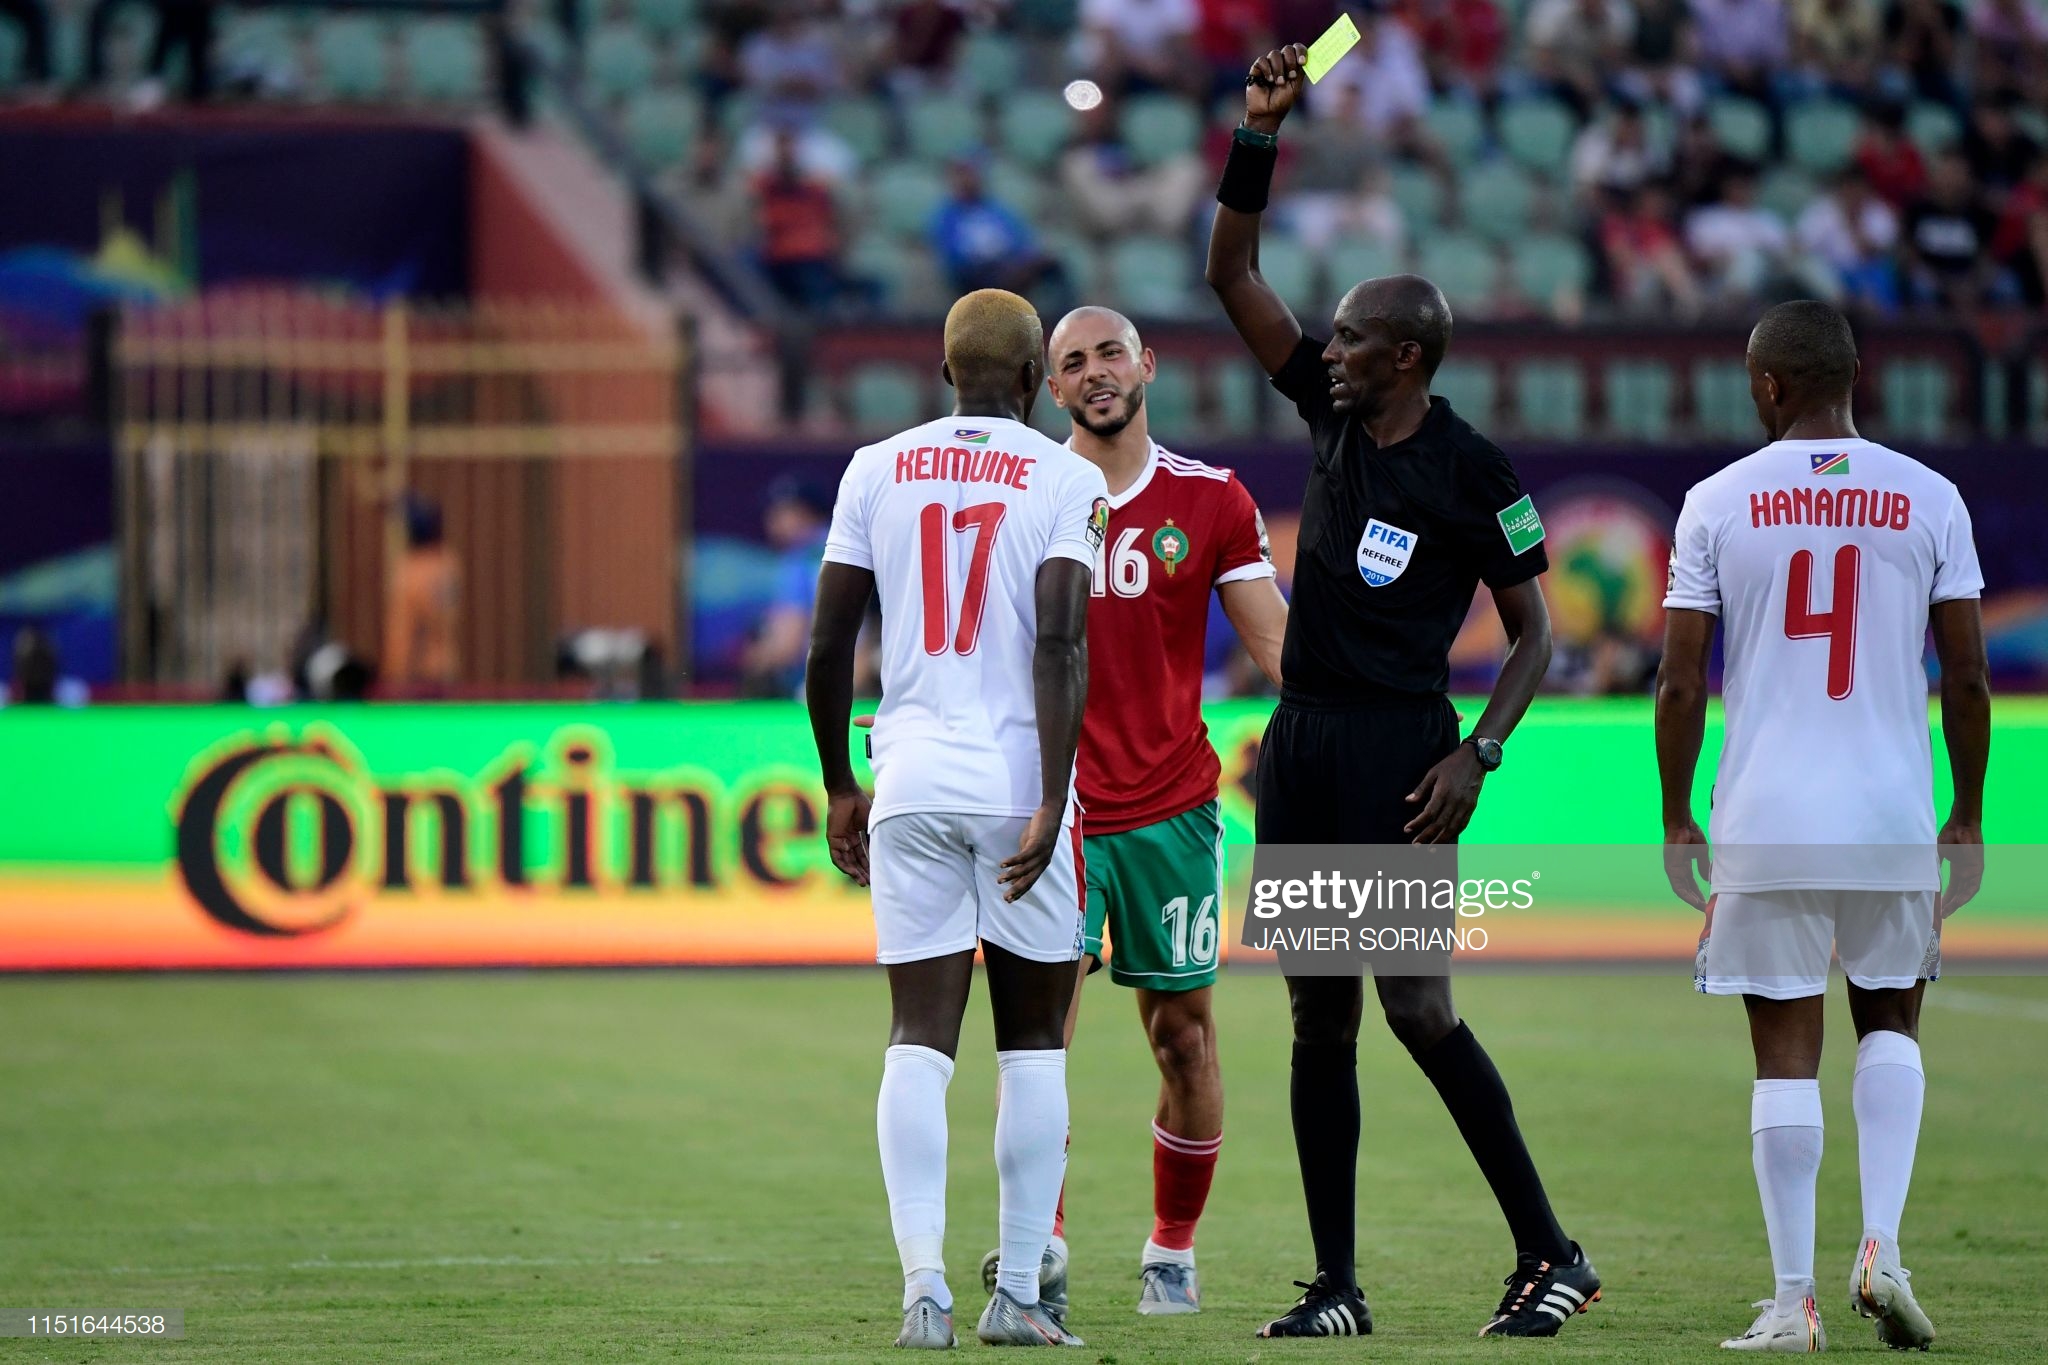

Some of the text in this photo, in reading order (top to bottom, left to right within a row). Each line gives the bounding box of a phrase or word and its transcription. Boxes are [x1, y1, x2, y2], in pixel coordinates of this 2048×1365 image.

[895, 446, 1036, 491] KEIMUINE
[1368, 524, 1408, 551] FIFA
[1750, 487, 1910, 531] HANAMUB
[919, 501, 1007, 657] 17
[1090, 527, 1149, 599] 16
[1362, 547, 1404, 569] REFEREE
[1366, 570, 1386, 583] 2019
[1784, 544, 1860, 701] 4
[177, 740, 822, 938] Contine
[1161, 894, 1216, 967] 16
